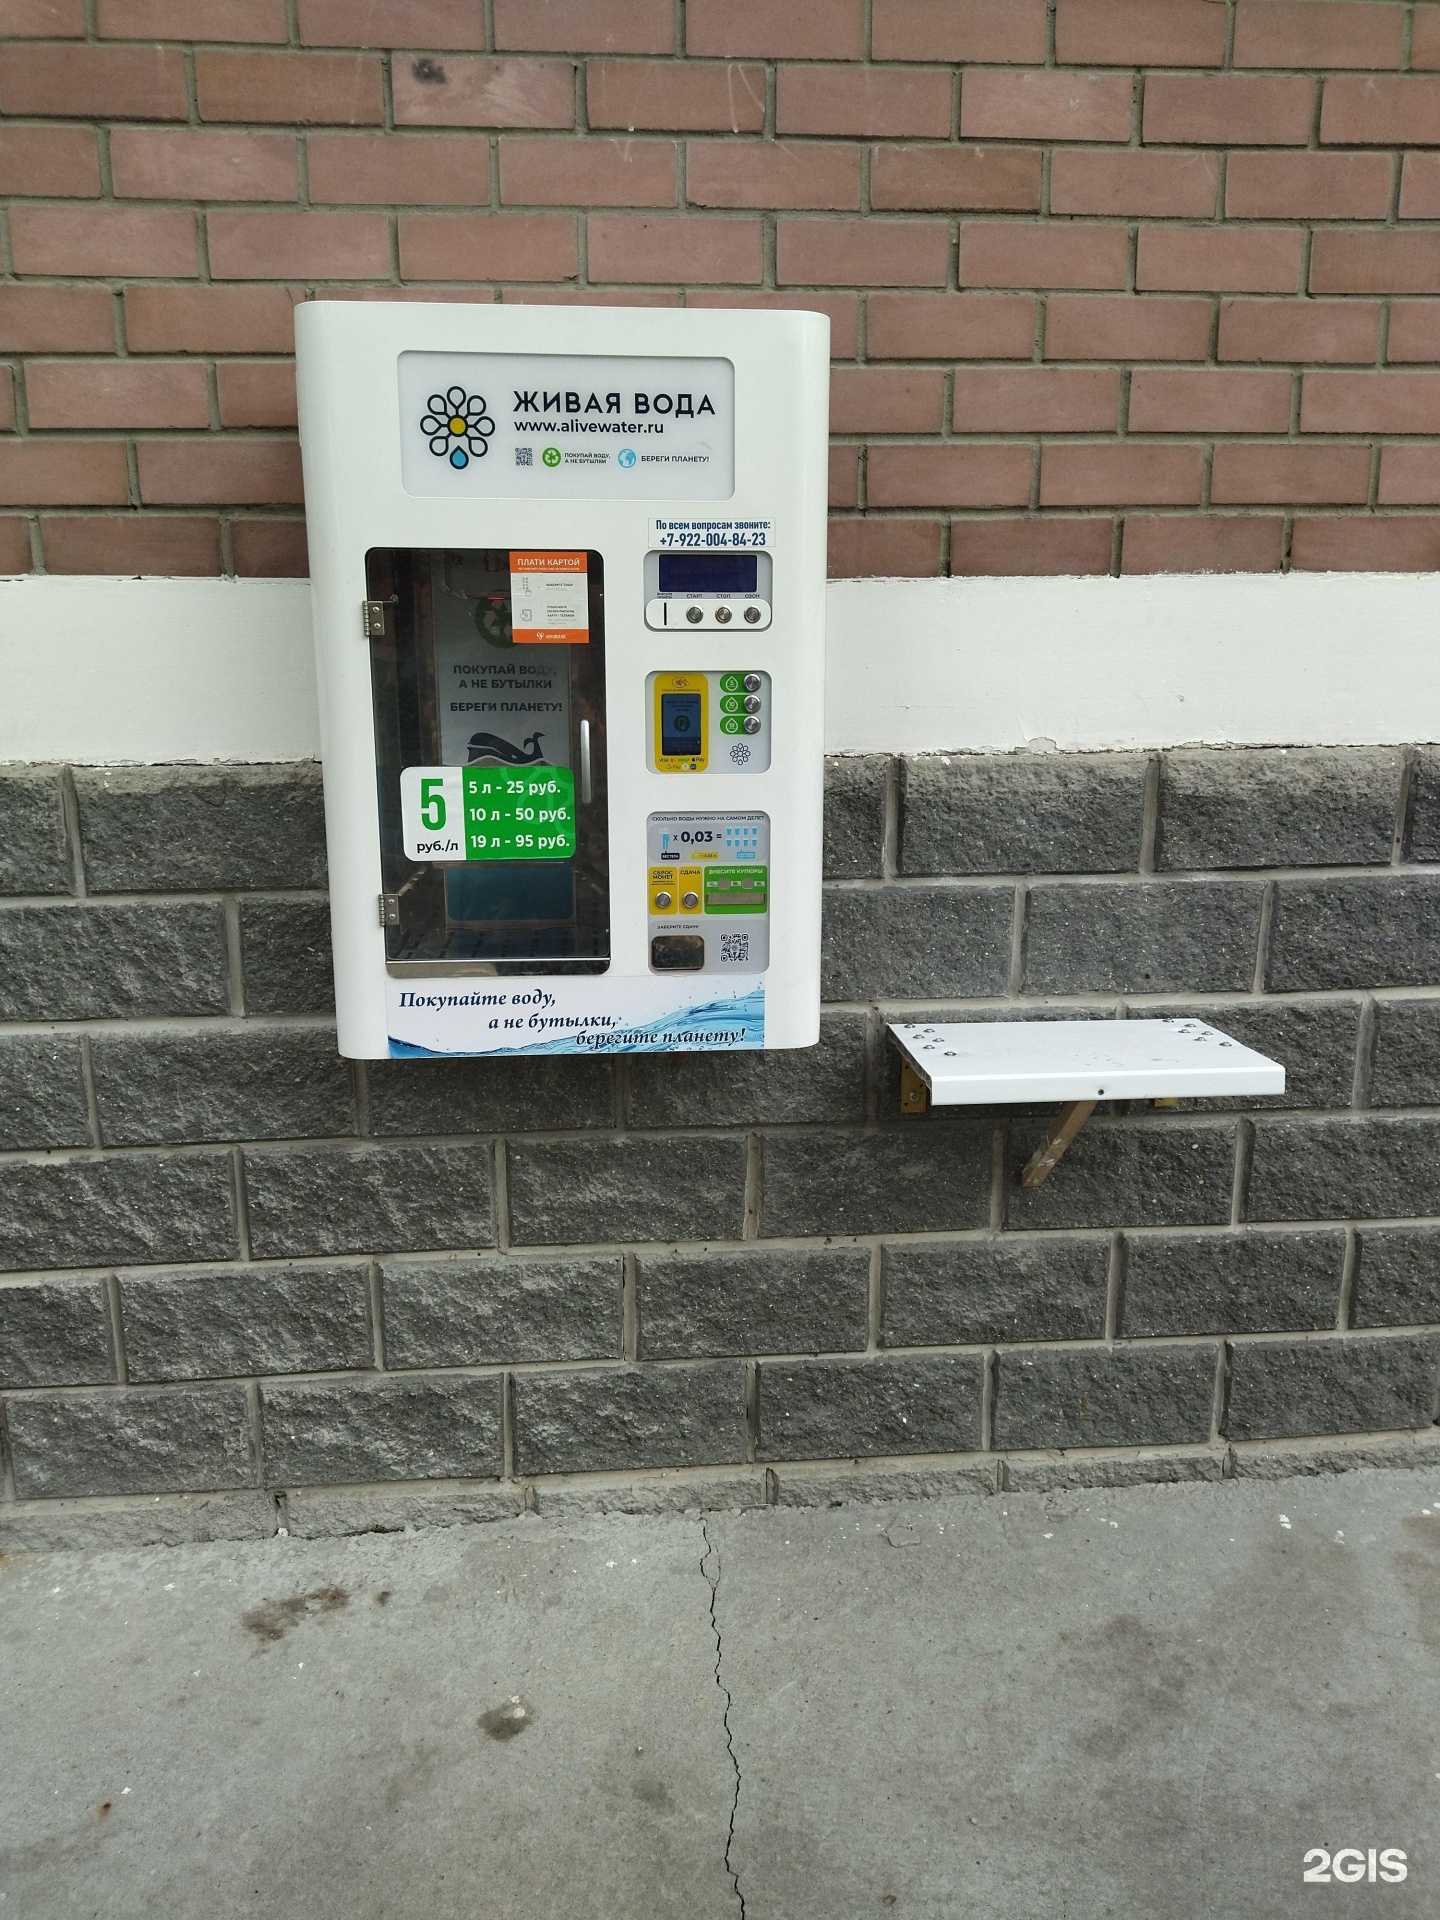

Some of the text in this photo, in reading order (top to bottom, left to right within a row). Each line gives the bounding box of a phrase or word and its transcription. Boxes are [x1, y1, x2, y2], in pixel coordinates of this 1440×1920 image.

[512, 390, 716, 418] ЖИВАЯ ВОДА
[514, 418, 664, 434] www.alivewater.ru
[671, 455, 710, 463] ПЛАНЕТУ!
[656, 519, 771, 532] По всем вопросам звоните:
[659, 532, 766, 547] +7-922-004-84-23
[517, 557, 580, 566] ПЛАТИ КАРТОЙ
[453, 663, 516, 675] ПОКУПАЙ
[458, 679, 552, 689] А НЕ БУТЫЛКИ
[449, 702, 563, 712] БЕРЕГИ ПЛАНЕТУ!
[469, 781, 478, 794] 5
[482, 783, 492, 794] л
[506, 781, 525, 794] 25
[528, 780, 561, 797] руб.
[420, 778, 447, 831] 5
[470, 808, 487, 821] 10
[490, 810, 500, 821] л
[515, 808, 535, 822] 50
[538, 807, 571, 824] руб.
[470, 835, 487, 848] 19
[490, 837, 500, 848] л
[515, 835, 534, 848] 95
[538, 834, 570, 850] руб.
[680, 830, 713, 845] 0,03
[416, 839, 459, 854] руб./л
[399, 990, 557, 1012] Покупайте воду,
[488, 1012, 616, 1031] а не бутылки,
[576, 1028, 746, 1050] берегите планету!
